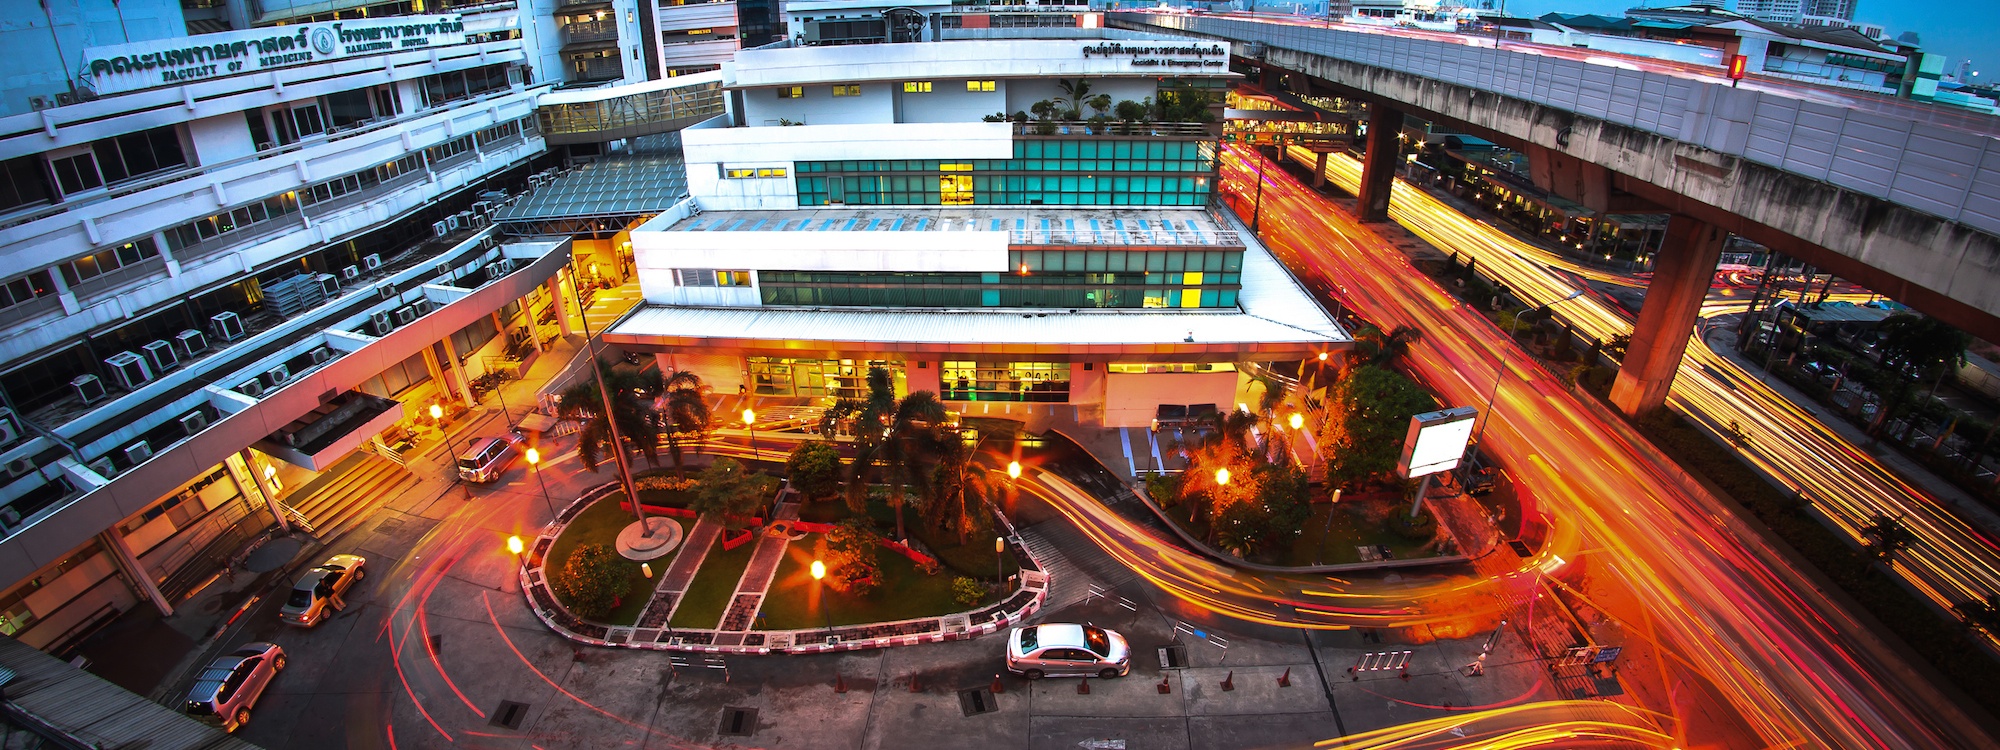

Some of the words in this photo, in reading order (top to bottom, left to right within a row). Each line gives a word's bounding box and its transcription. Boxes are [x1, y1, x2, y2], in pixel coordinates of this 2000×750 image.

[401, 38, 429, 47] HOSPITAL
[162, 64, 217, 82] FACULTY
[227, 61, 242, 72] OF
[259, 51, 313, 67] MEDICINE
[1168, 59, 1202, 68] Emergency
